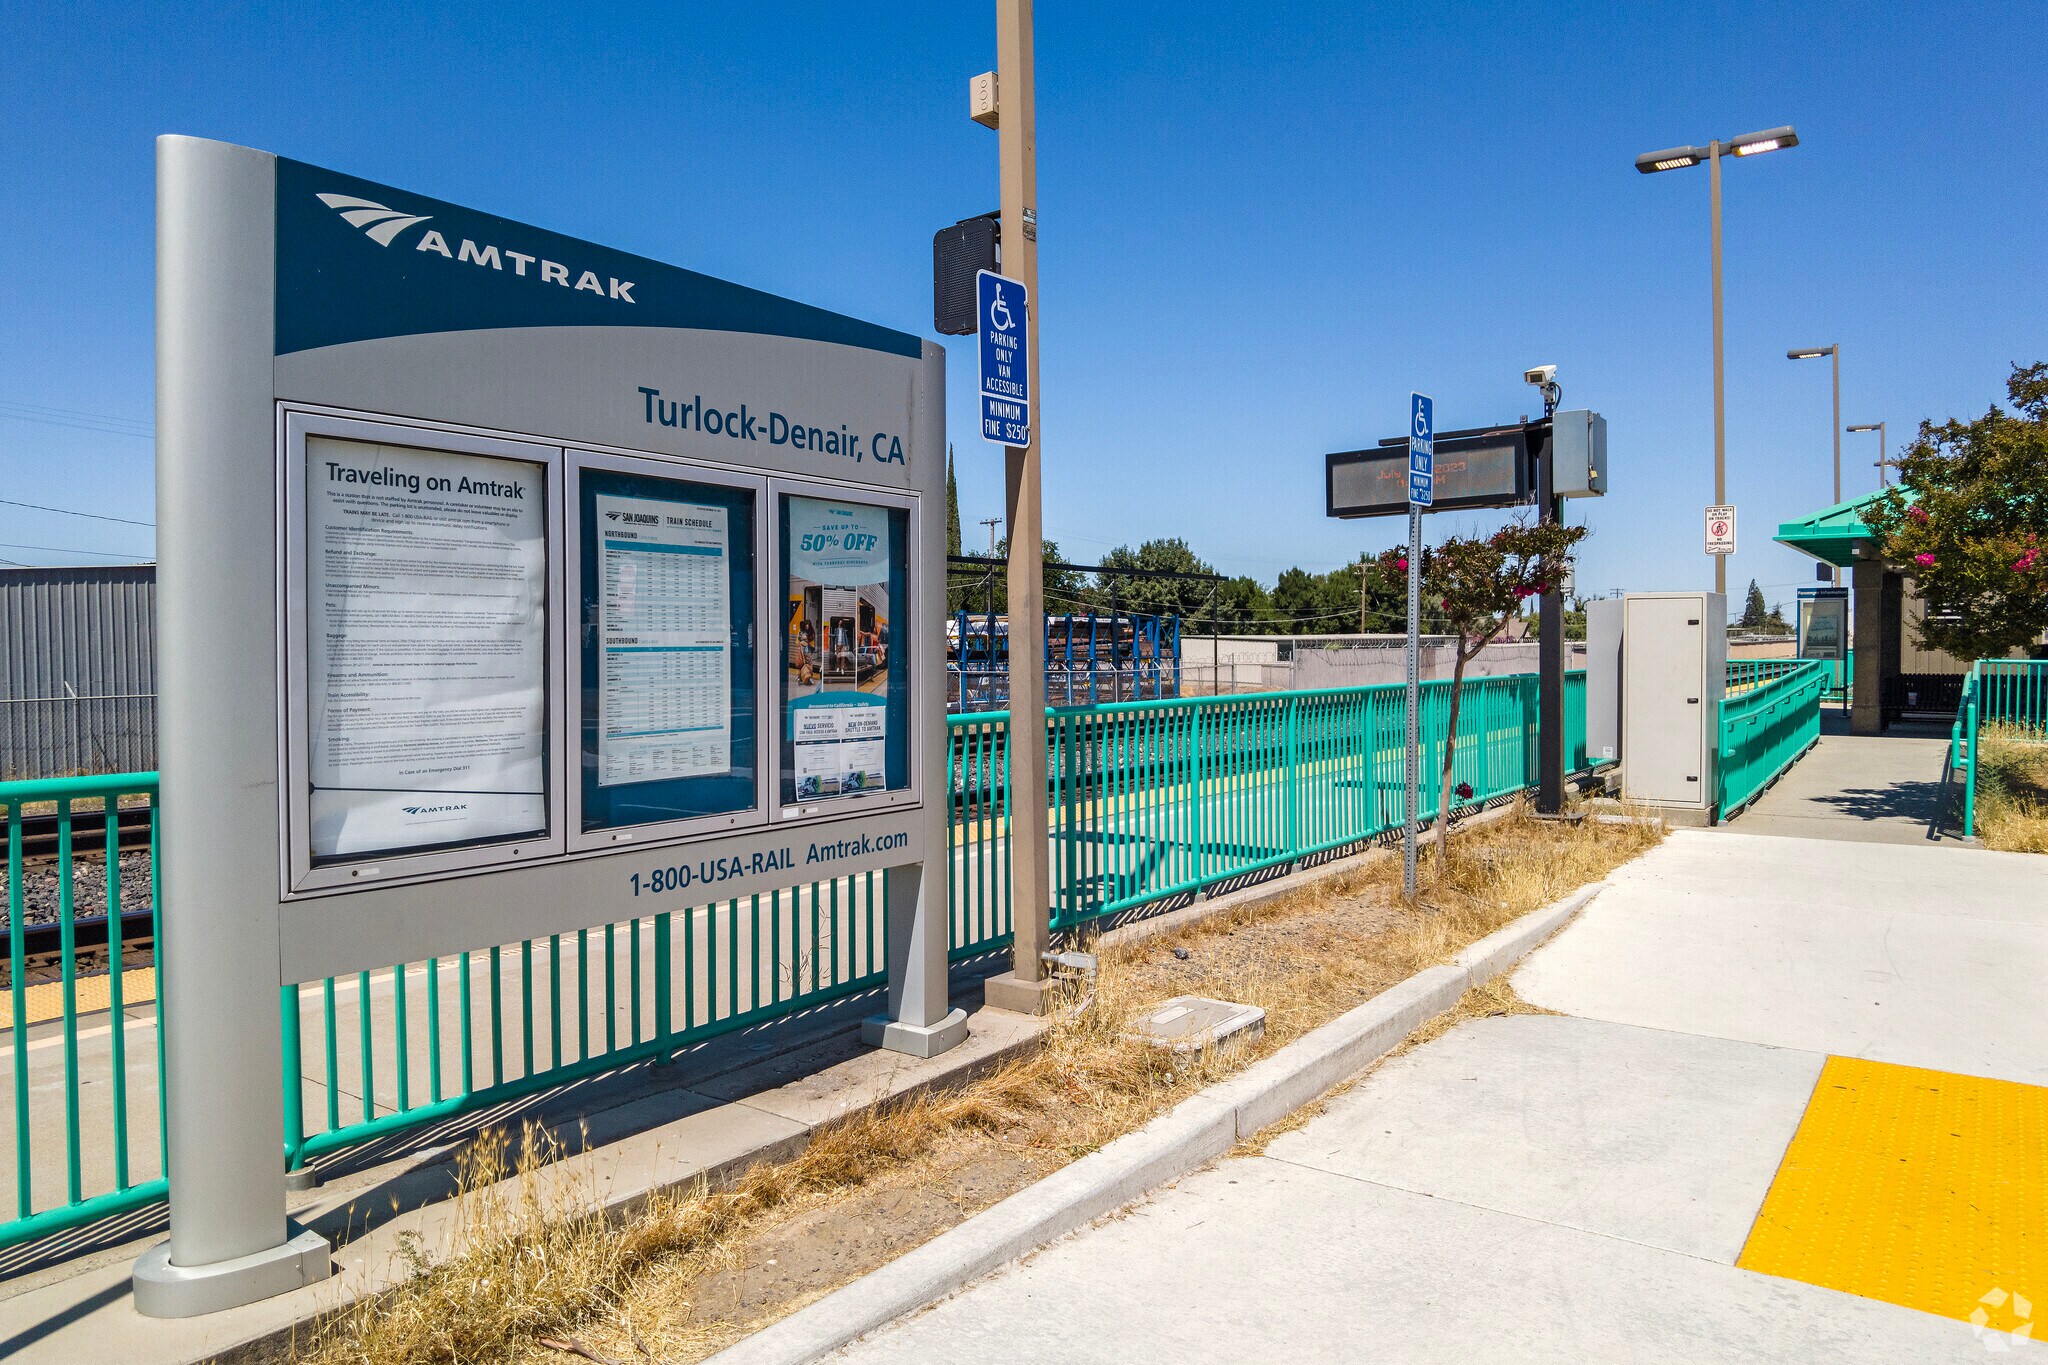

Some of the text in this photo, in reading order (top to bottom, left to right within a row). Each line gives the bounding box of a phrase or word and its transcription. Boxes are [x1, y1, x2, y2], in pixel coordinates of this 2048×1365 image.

[416, 229, 636, 305] AMTRAK
[990, 331, 1018, 350] PARKING
[996, 348, 1013, 364] ONLY
[998, 364, 1011, 379] VAN
[986, 378, 1023, 397] ACCESSIBLE
[990, 400, 1021, 421] MINIMUM
[638, 386, 905, 467] Turlock-Denair, CA
[985, 419, 1026, 441] FINE $250
[1411, 436, 1432, 456] PARKING
[1414, 455, 1428, 472] ONLY
[325, 462, 524, 499] Traveling on Amtrak
[1411, 488, 1419, 499] FINE
[622, 512, 634, 522] SAN
[634, 514, 659, 525] JOAQUINS
[666, 517, 683, 525] TRAIN
[684, 519, 712, 528] SCHEDULE
[605, 530, 637, 539] NORTHBOUND
[800, 533, 878, 552] 50% OFF
[420, 804, 467, 813] AMTRAK
[629, 832, 908, 897] 1-800-USA-RAIL Amtrak.com
